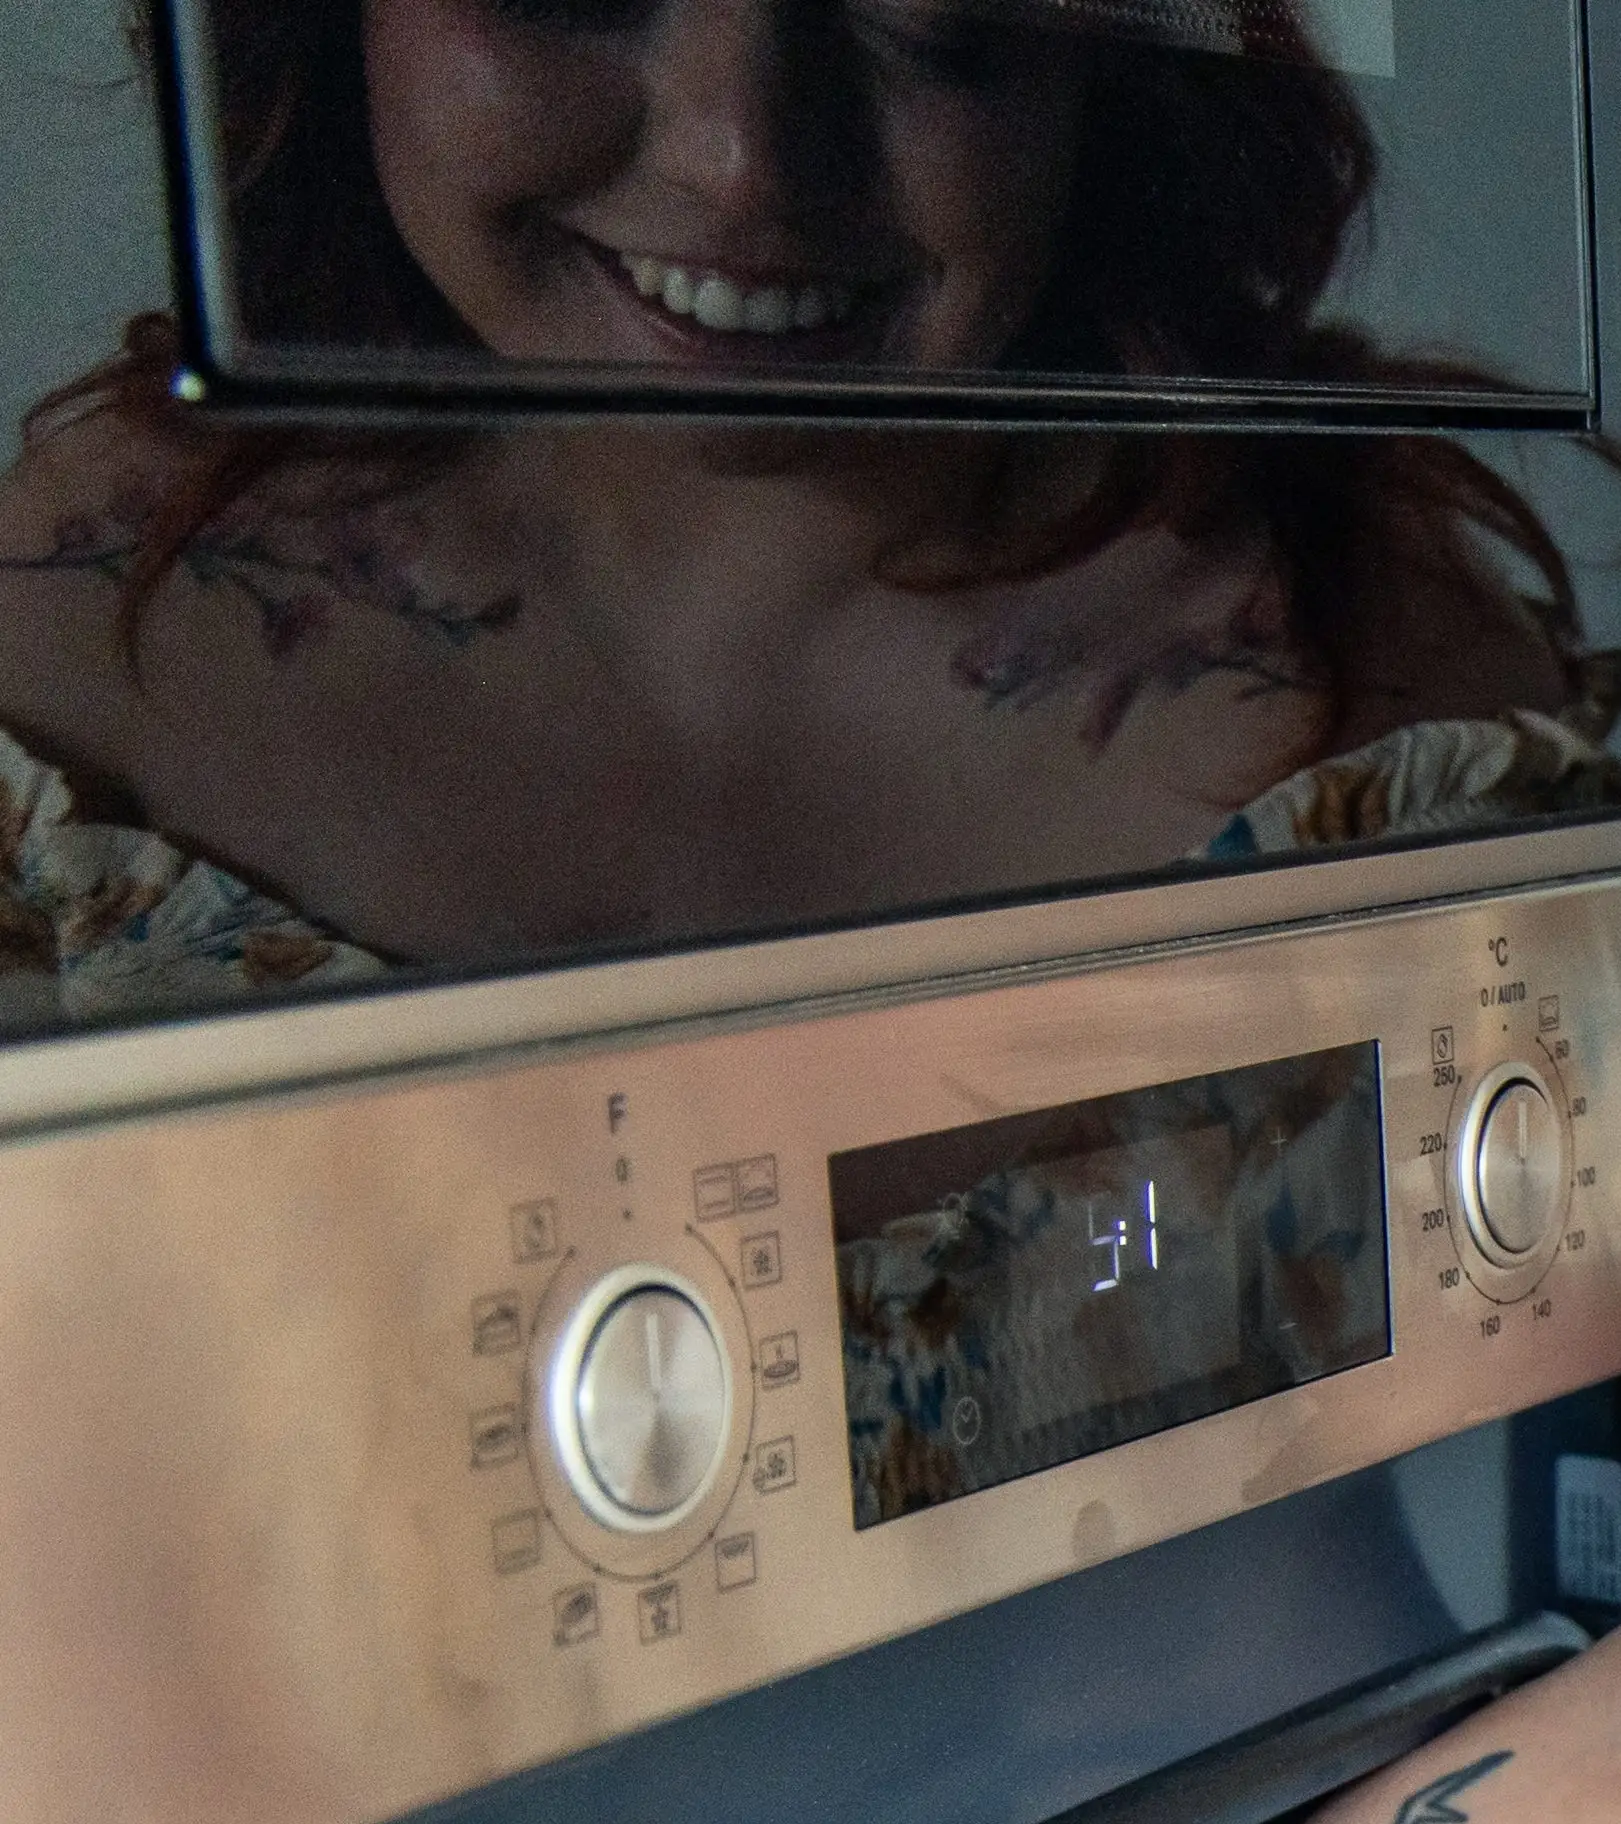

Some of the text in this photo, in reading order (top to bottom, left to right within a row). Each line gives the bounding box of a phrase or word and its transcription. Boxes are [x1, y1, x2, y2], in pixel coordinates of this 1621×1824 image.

[1487, 937, 1508, 966] °C
[1433, 1064, 1455, 1087] 250
[607, 1092, 629, 1134] F
[1420, 1132, 1442, 1155] 220
[1577, 1165, 1596, 1187] 100
[1422, 1208, 1444, 1231] 200
[1565, 1229, 1586, 1252] 120
[1439, 1267, 1460, 1290] 180
[1532, 1298, 1552, 1321] 140
[1480, 1315, 1500, 1340] 160
